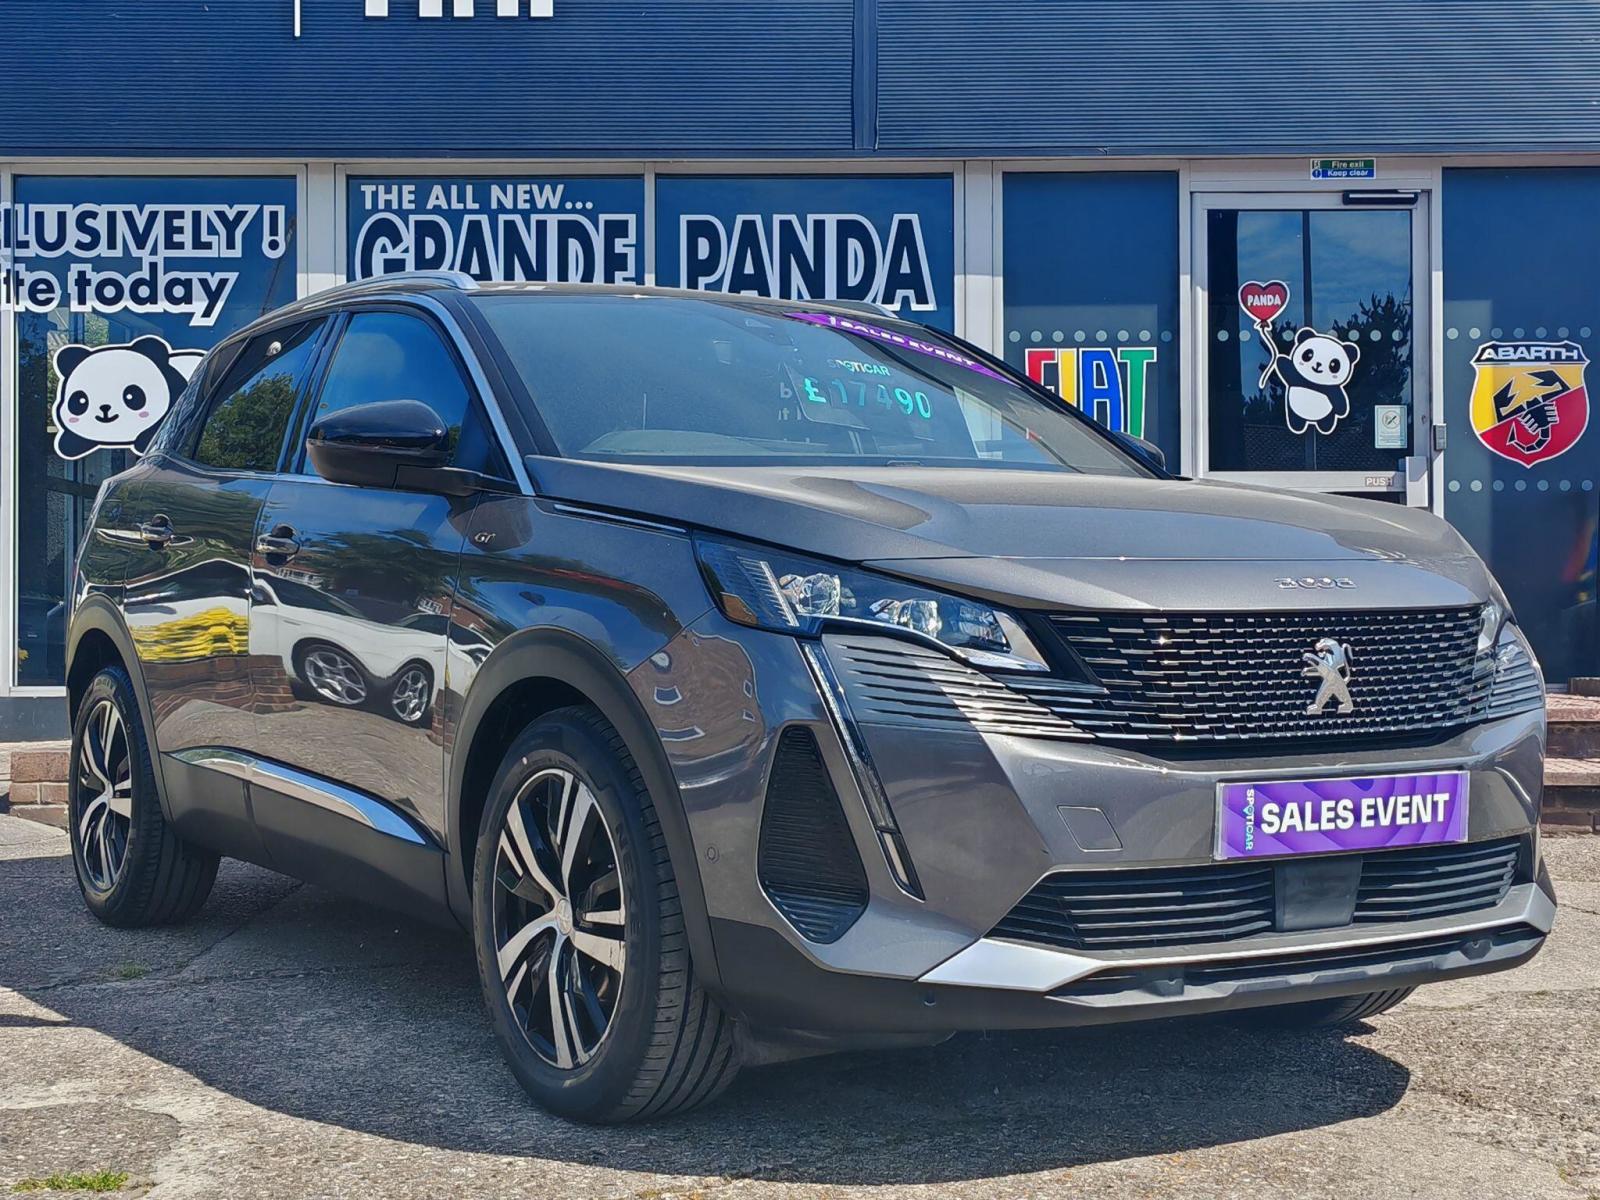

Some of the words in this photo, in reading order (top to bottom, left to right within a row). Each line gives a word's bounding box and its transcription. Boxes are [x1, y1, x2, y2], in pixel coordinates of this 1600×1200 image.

[1327, 169, 1347, 177] Keep
[361, 184, 415, 209] THE
[426, 184, 480, 209] ALL
[490, 184, 594, 209] NEW...
[682, 213, 937, 311] PANDA
[68, 256, 239, 326] today
[1247, 294, 1281, 306] PANDA
[1480, 346, 1578, 360] ABARTH
[1366, 477, 1393, 486] PUSH
[1261, 799, 1354, 834] SALES
[1360, 793, 1450, 828] EVENT
